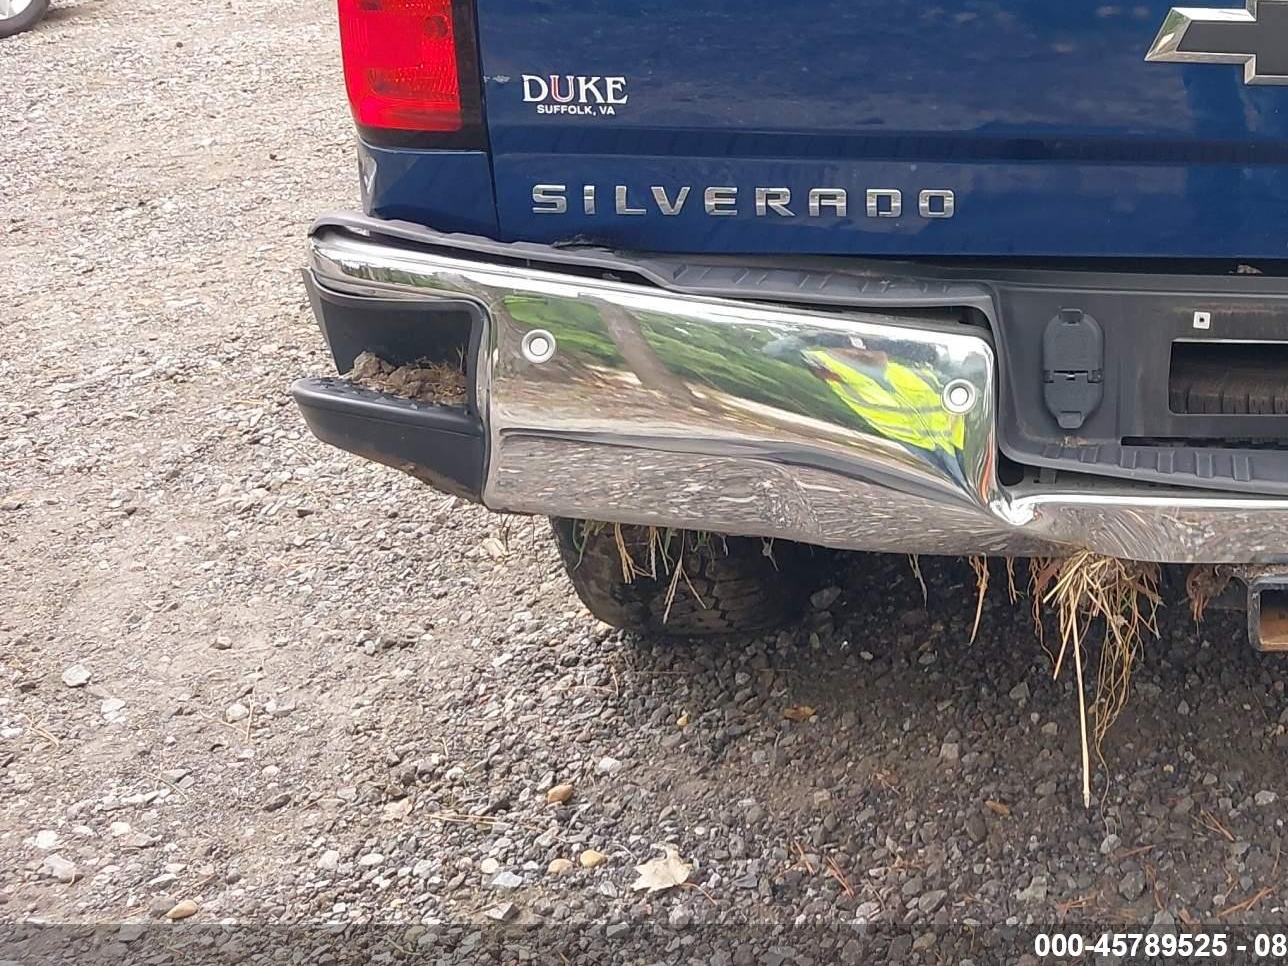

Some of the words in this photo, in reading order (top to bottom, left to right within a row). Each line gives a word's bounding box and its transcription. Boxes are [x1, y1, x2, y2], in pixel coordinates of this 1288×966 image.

[521, 74, 628, 104] DUKE
[536, 104, 597, 116] SUFFOLK,
[599, 105, 616, 115] VA
[532, 184, 955, 219] SILVERADO
